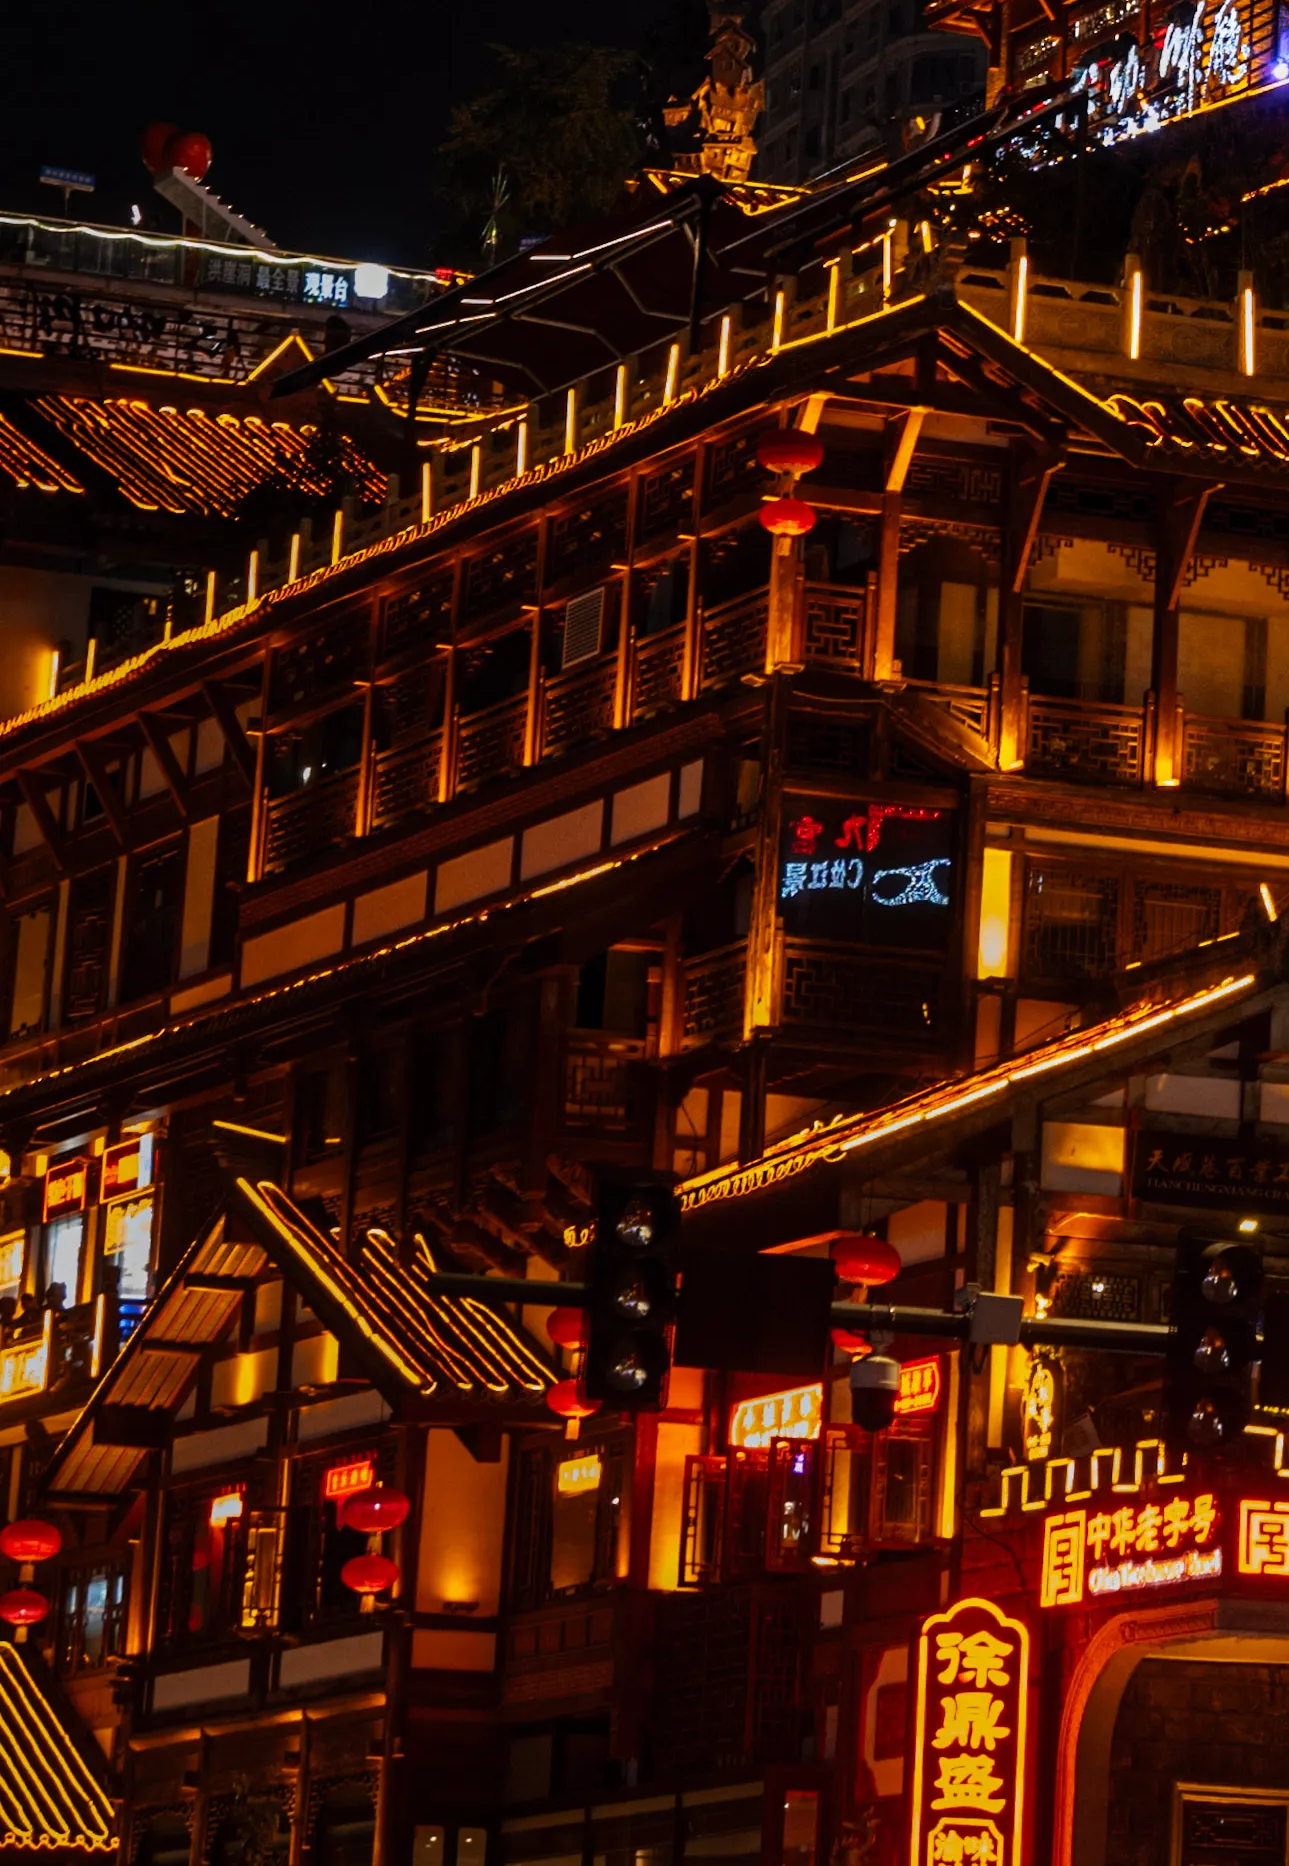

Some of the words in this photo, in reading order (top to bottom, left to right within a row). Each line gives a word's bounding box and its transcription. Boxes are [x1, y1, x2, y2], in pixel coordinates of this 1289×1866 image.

[1086, 1493, 1217, 1561] 中华老字号
[930, 1630, 1014, 1814] 徐鼎盛
